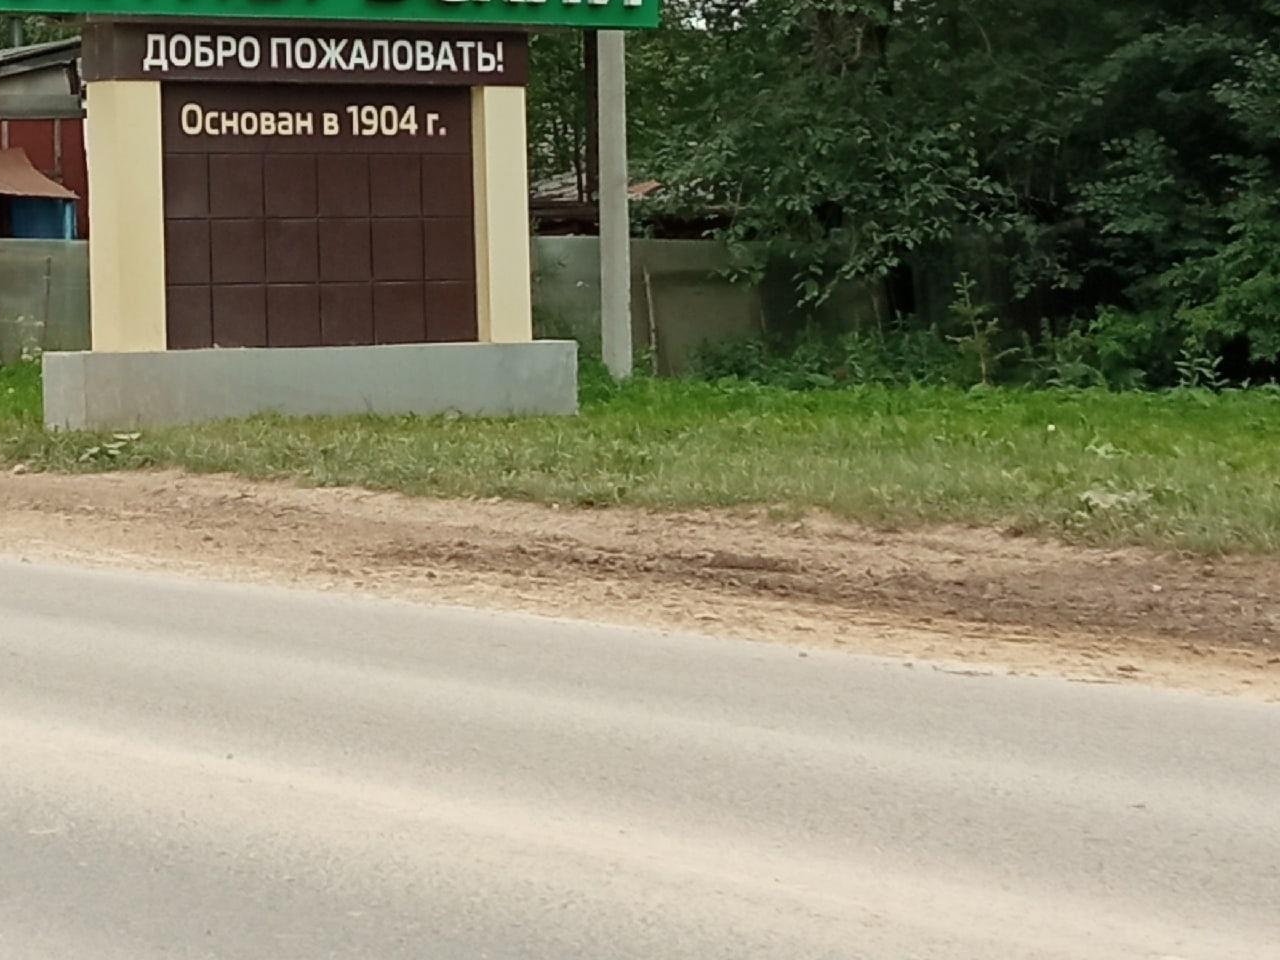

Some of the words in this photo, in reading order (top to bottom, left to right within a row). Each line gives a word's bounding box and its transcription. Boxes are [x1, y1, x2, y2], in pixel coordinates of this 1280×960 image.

[143, 33, 260, 71] ДОБРО
[270, 37, 504, 73] ПОЖАЛОВАТЬ!
[181, 103, 314, 136] Основан
[323, 113, 340, 136] в
[346, 105, 418, 136] 1904
[427, 112, 447, 136] г.
